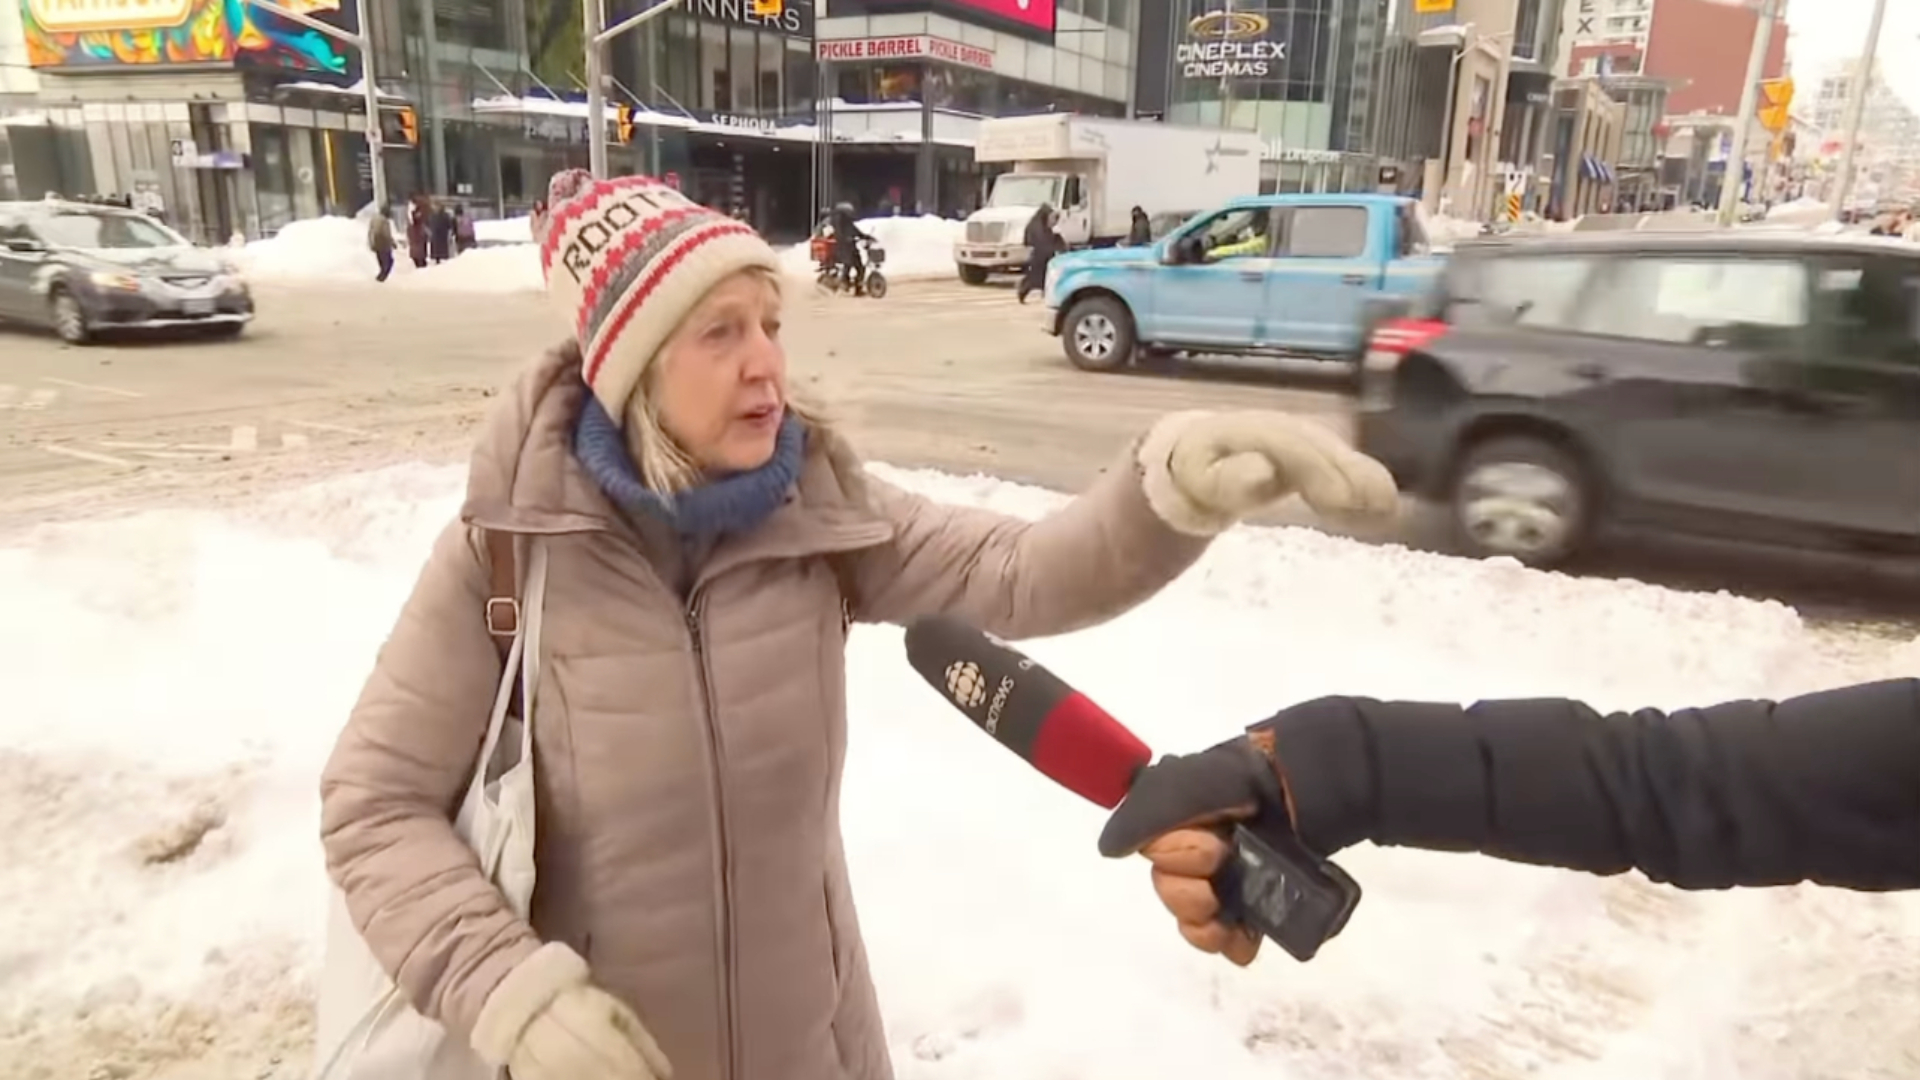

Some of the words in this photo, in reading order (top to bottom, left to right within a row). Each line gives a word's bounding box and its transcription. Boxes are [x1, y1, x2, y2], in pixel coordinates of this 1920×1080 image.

[684, 0, 800, 31] INNERS
[819, 42, 863, 58] PICKLE
[867, 39, 922, 56] BARREL
[929, 40, 957, 59] PICKLE
[1176, 41, 1286, 62] CINEPLEX
[1184, 60, 1269, 77] CINEMAS
[711, 113, 777, 134] SEPHORA
